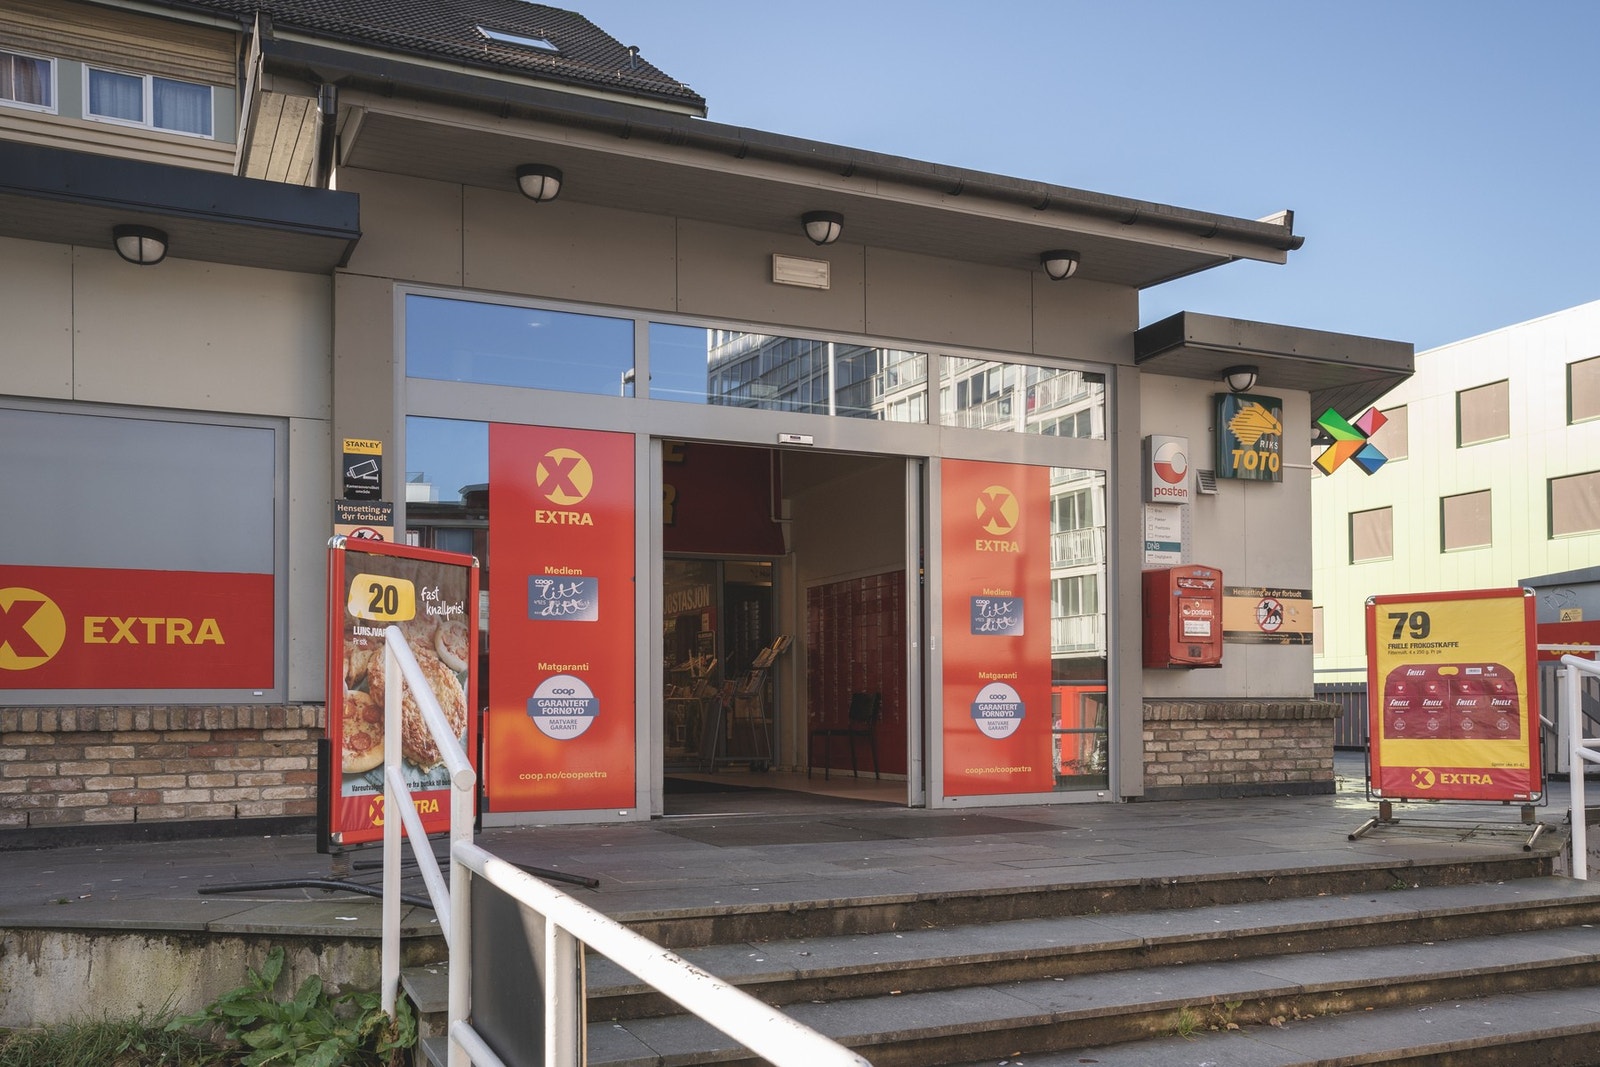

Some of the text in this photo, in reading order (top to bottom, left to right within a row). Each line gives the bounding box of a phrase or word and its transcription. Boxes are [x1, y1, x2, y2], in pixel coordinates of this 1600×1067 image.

[345, 440, 380, 449] STANLEY
[1260, 440, 1278, 450] RIKS
[1232, 450, 1280, 473] TOTO
[1153, 486, 1188, 498] posten
[337, 504, 380, 515] Hensetting
[341, 512, 387, 521] dyr forbudt
[535, 509, 594, 526] EXTRA
[975, 539, 1020, 553] EXTRA
[544, 566, 583, 576] Medlem
[421, 586, 440, 602] fast
[983, 588, 1012, 596] Medlem
[1232, 588, 1263, 597] Hensetting
[1272, 590, 1281, 598] dyr
[1282, 590, 1302, 598] forbudt
[368, 583, 399, 615] 20
[426, 601, 464, 620] knallpris!
[1191, 608, 1212, 616] posten
[84, 616, 226, 645] EXTRA
[1388, 611, 1431, 640] 79
[1410, 641, 1459, 649] FROKOSTKAFFE
[538, 662, 589, 673] Matgaranti
[978, 671, 1018, 680] Matgaranti
[552, 688, 575, 696] coop
[542, 707, 585, 715] FORNØYD
[519, 771, 607, 782] coop.no/coopextra
[965, 766, 1032, 776] coop.no/coopextra
[1440, 774, 1493, 785] EXTRA
[414, 799, 439, 814] TRA
